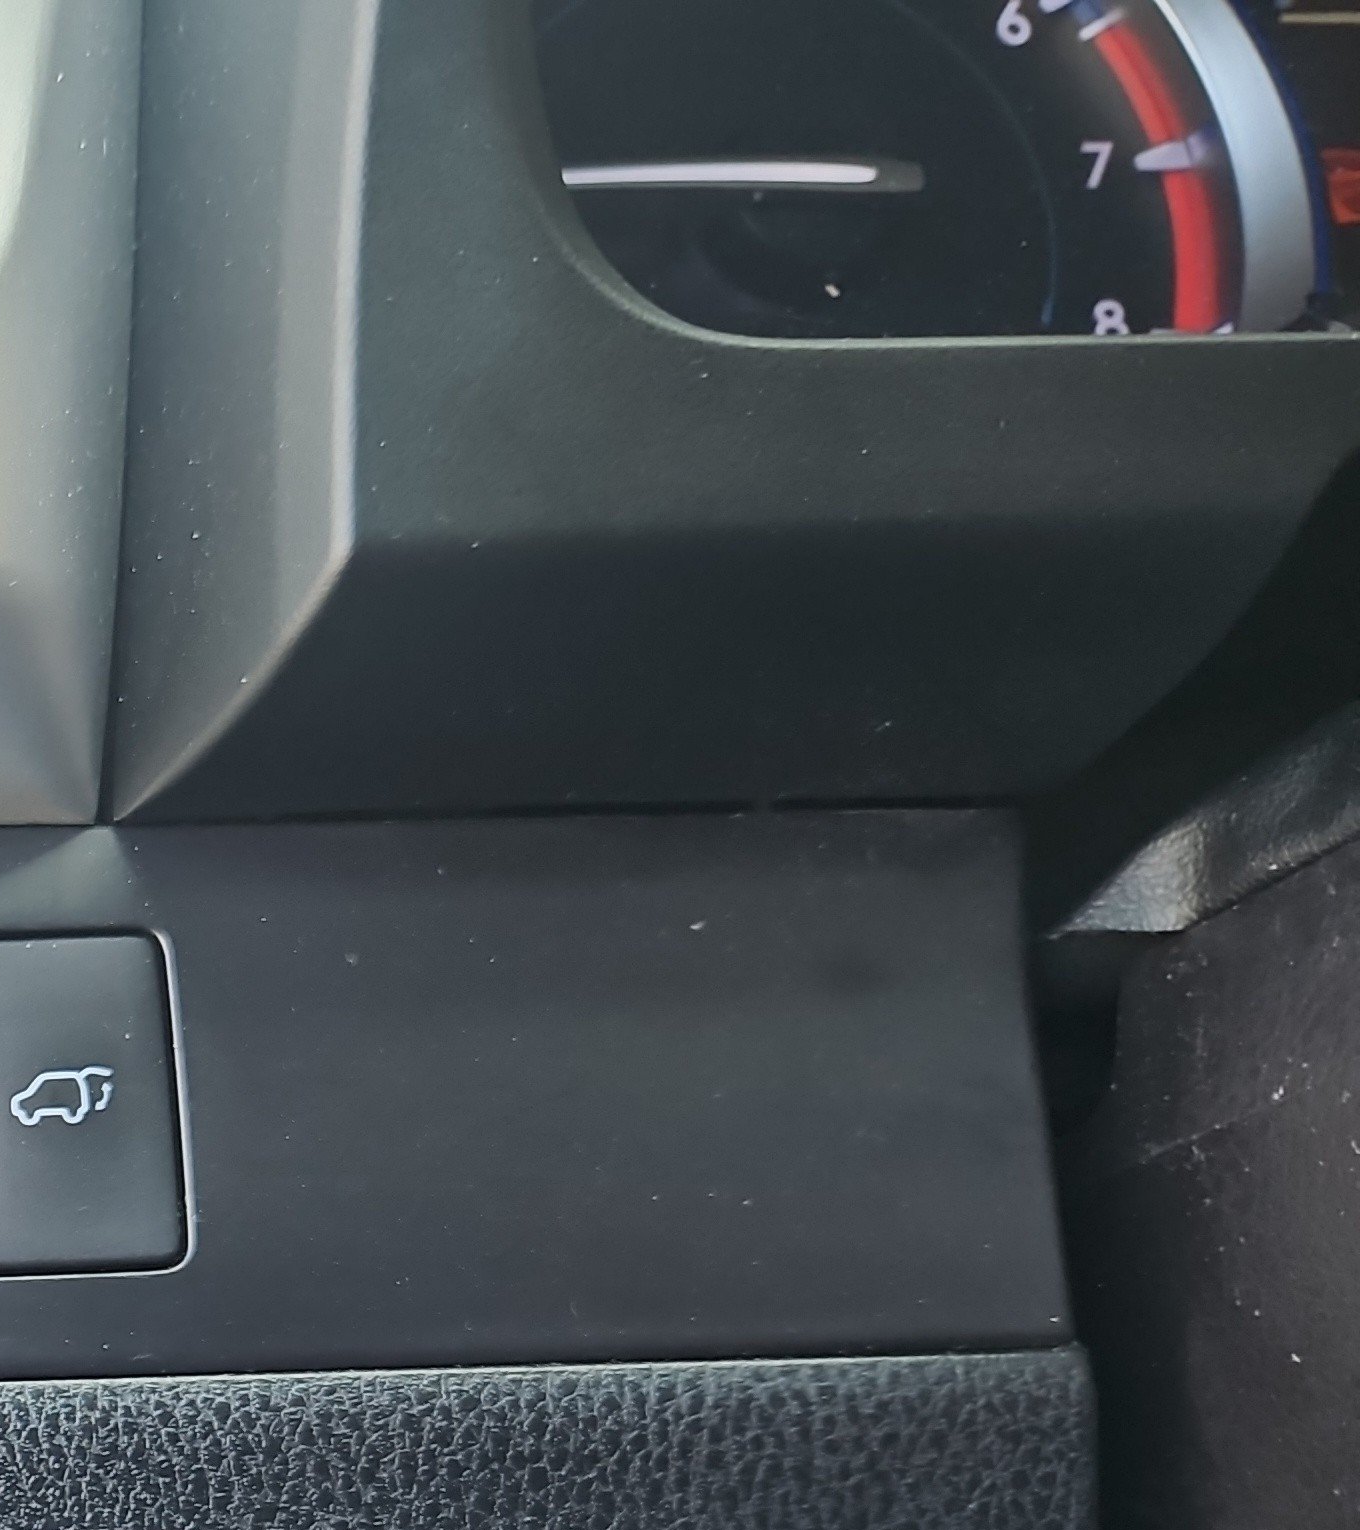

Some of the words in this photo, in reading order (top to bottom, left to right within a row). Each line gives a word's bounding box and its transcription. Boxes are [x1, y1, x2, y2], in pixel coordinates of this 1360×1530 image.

[995, 0, 1032, 47] 6
[1080, 141, 1114, 189] 7
[1093, 299, 1130, 336] 8
